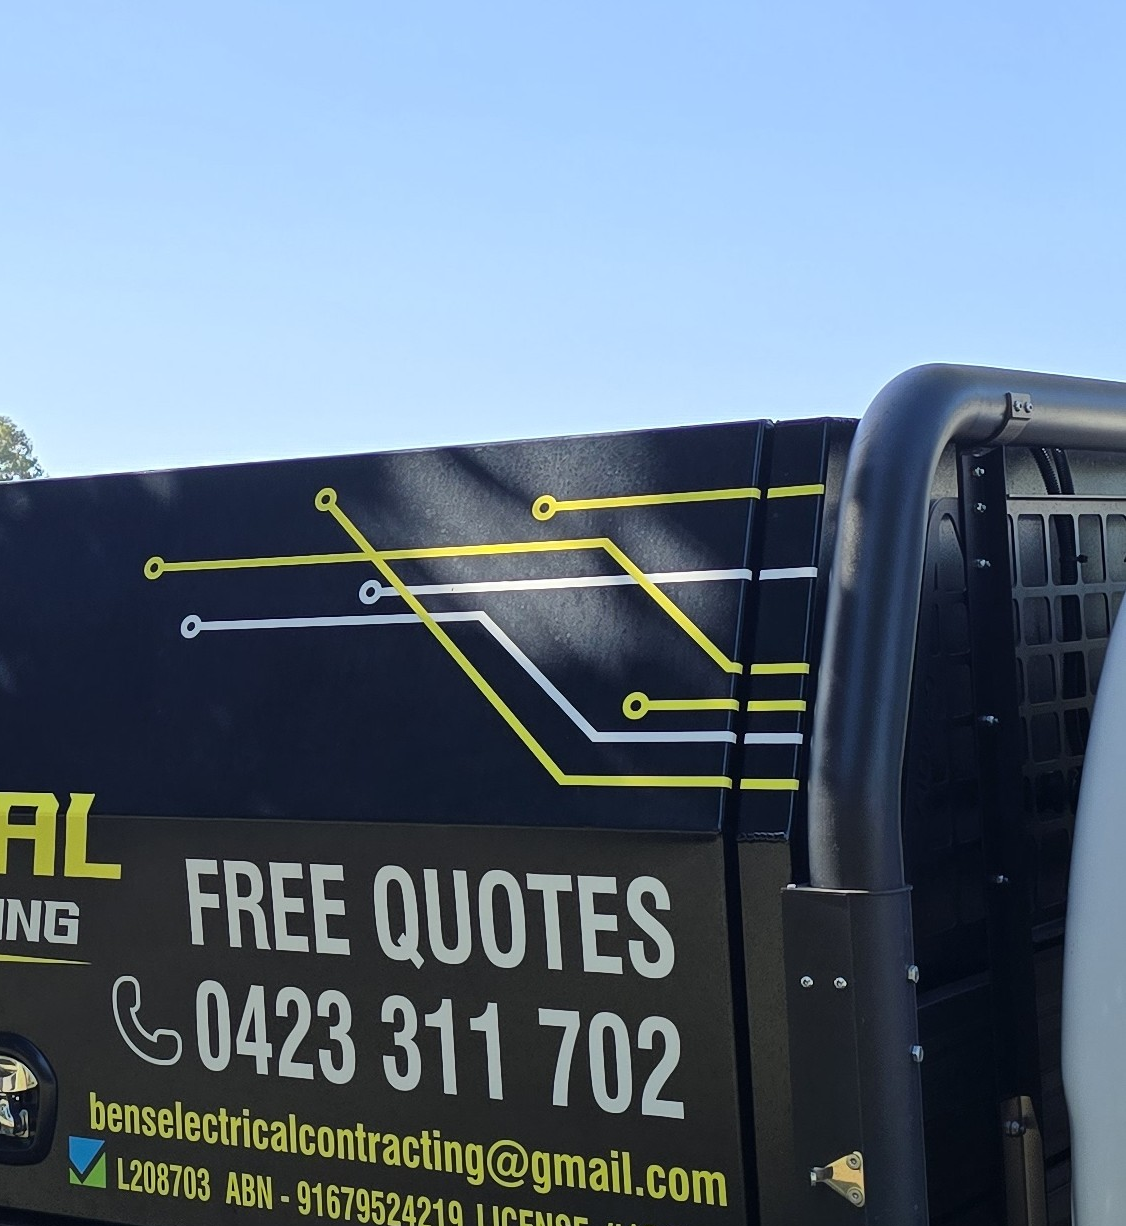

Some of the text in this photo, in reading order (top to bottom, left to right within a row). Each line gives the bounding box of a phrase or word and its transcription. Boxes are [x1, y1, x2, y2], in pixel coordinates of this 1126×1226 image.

[185, 858, 675, 979] FREE QUOTES
[195, 981, 685, 1119] 0423 311 702
[90, 1092, 728, 1206] benselectricalcontracting@gmail.com
[116, 1158, 211, 1201] L208703
[225, 1172, 273, 1209] ABN
